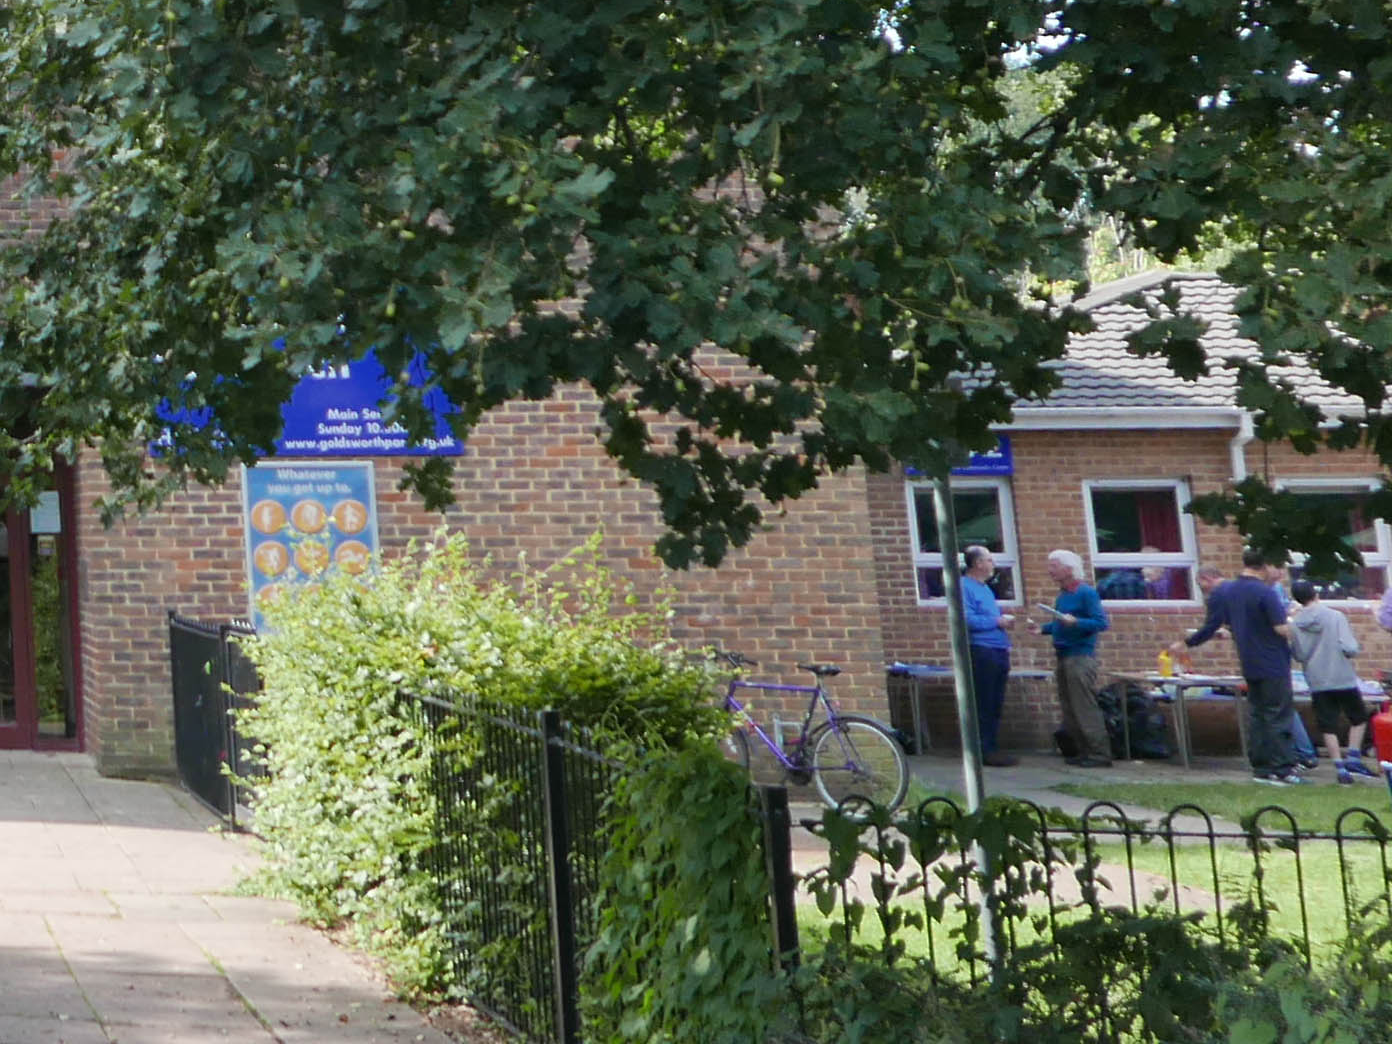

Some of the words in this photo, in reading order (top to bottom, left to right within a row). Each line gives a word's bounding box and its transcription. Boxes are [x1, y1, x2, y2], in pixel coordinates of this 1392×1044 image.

[328, 408, 358, 420] Main
[318, 423, 362, 436] Sunday
[277, 468, 337, 481] Whatever
[267, 483, 290, 494] you
[317, 483, 333, 495] up
